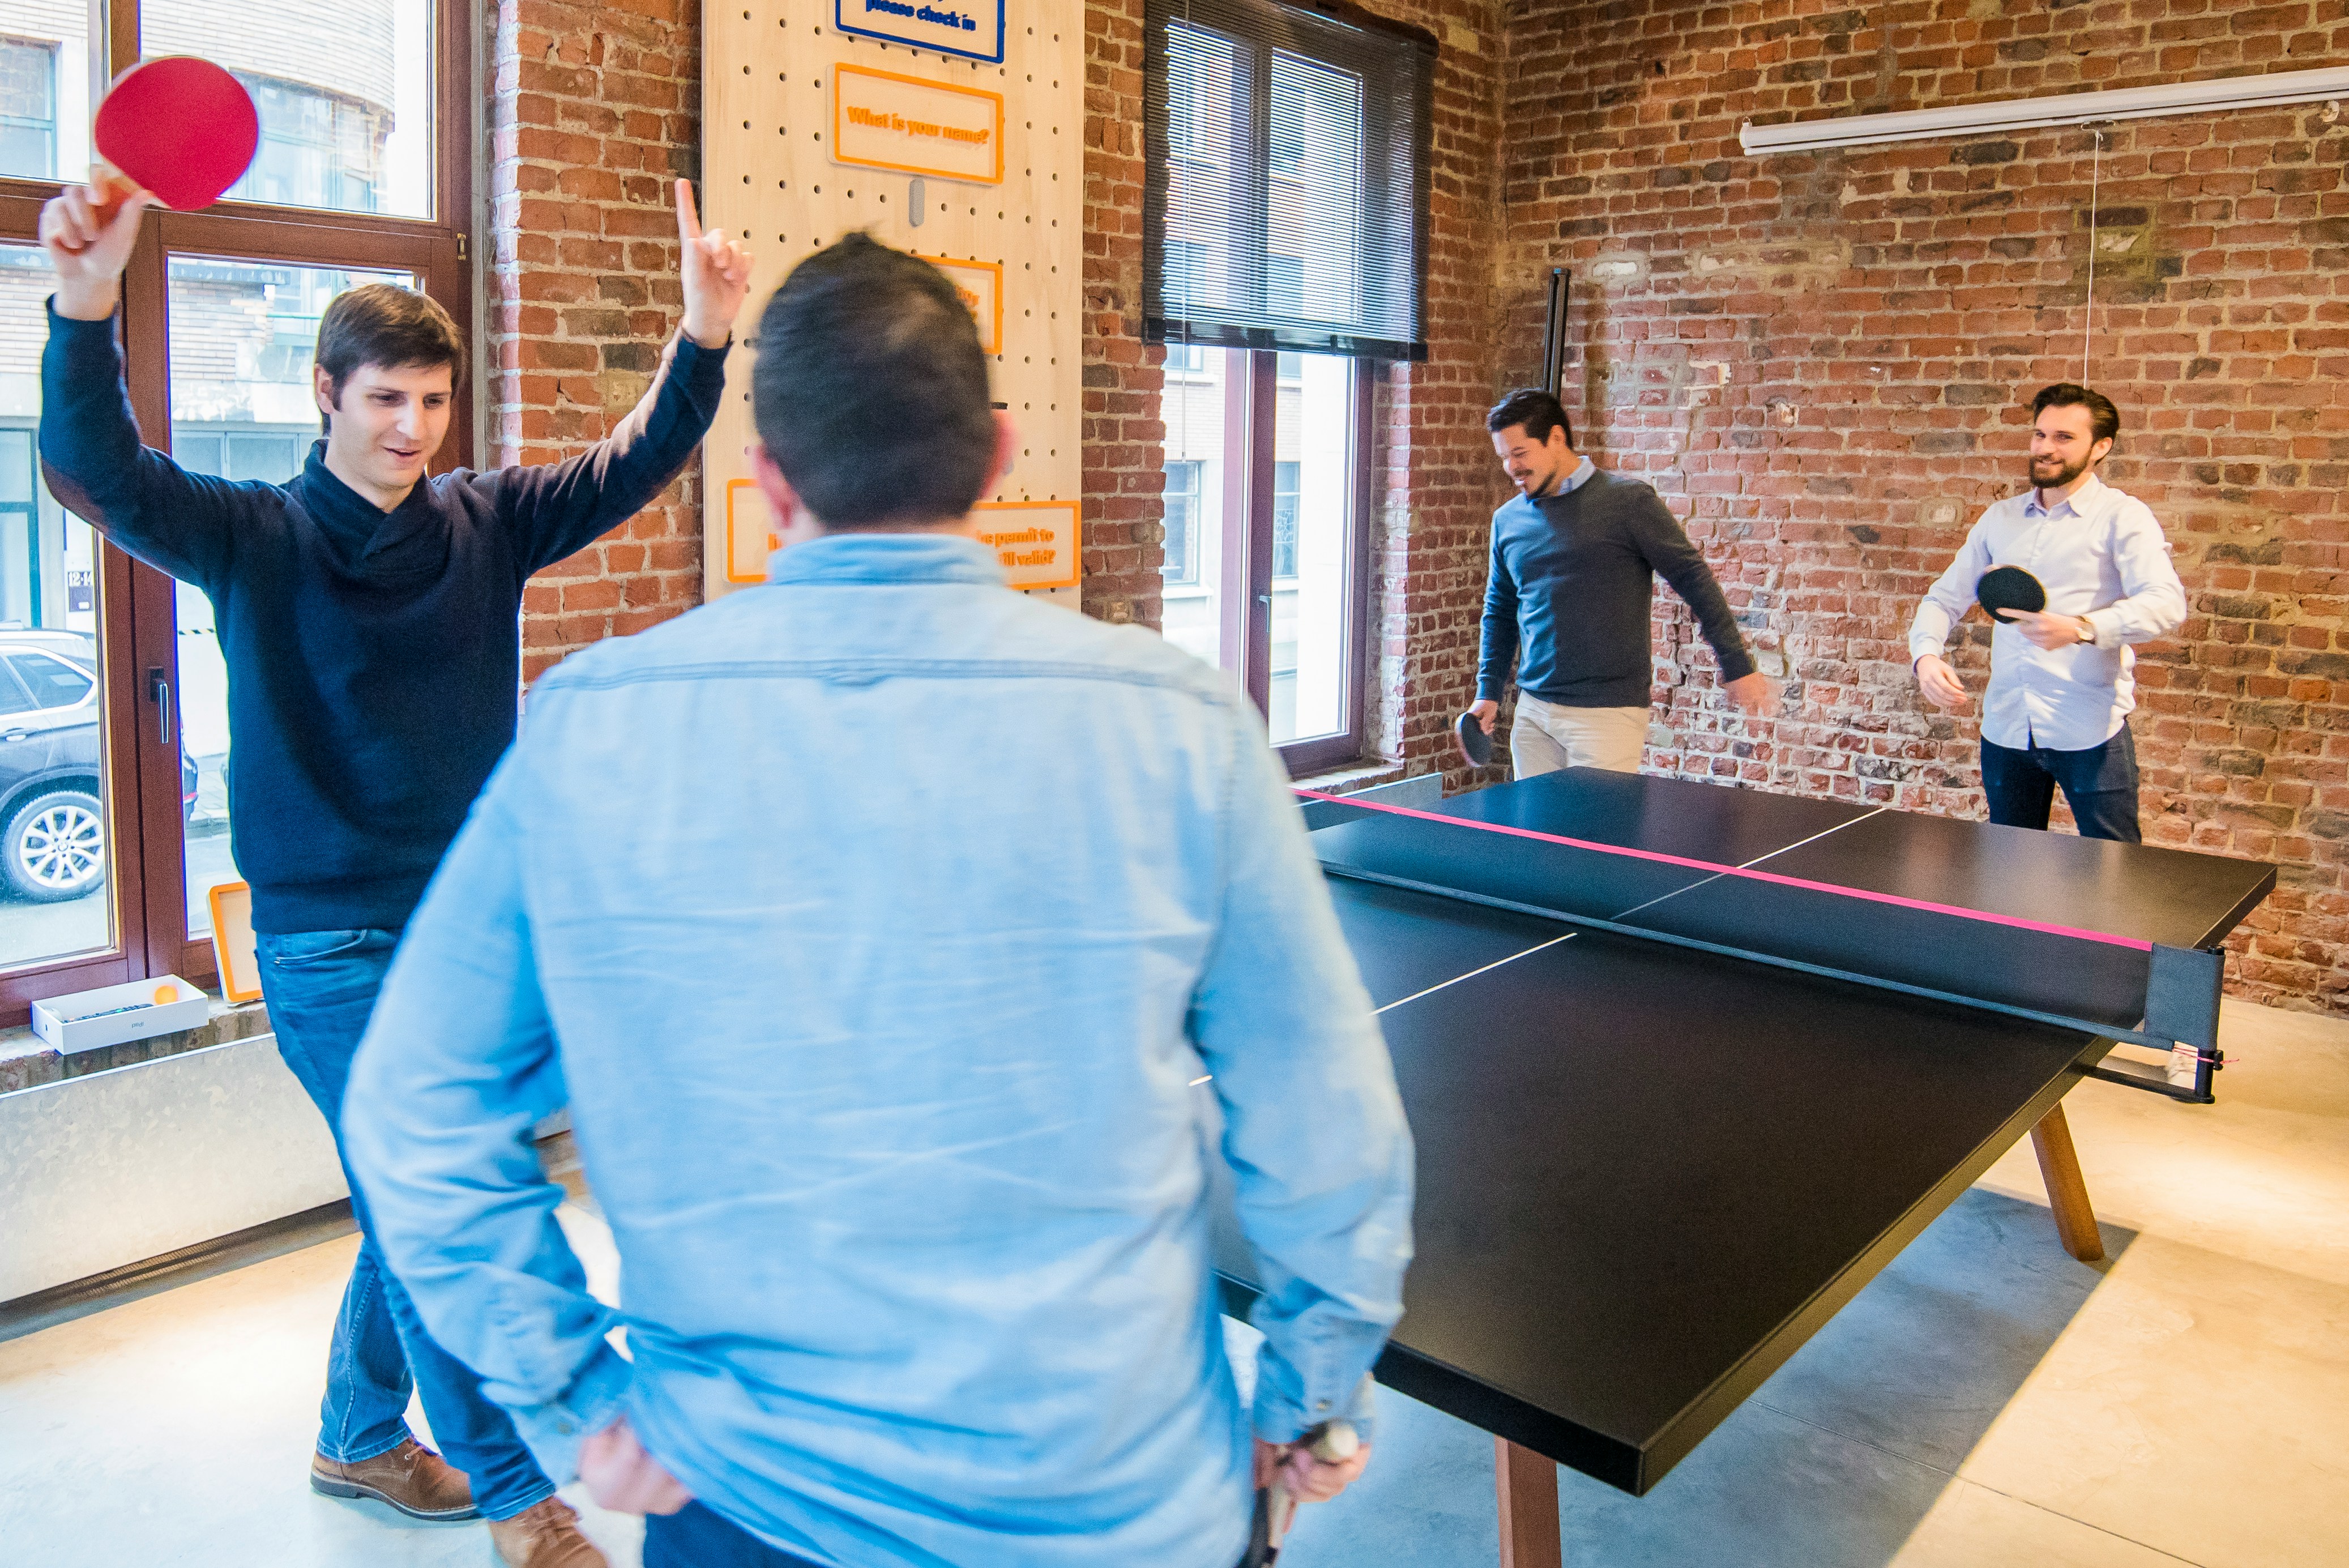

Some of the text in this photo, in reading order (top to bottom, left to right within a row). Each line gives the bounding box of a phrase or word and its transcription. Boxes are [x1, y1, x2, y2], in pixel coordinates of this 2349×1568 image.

[866, 0, 976, 31] please check in
[847, 106, 990, 144] What is your name?
[995, 527, 1039, 548] permit
[1040, 529, 1055, 542] to
[1017, 550, 1056, 565] valid?
